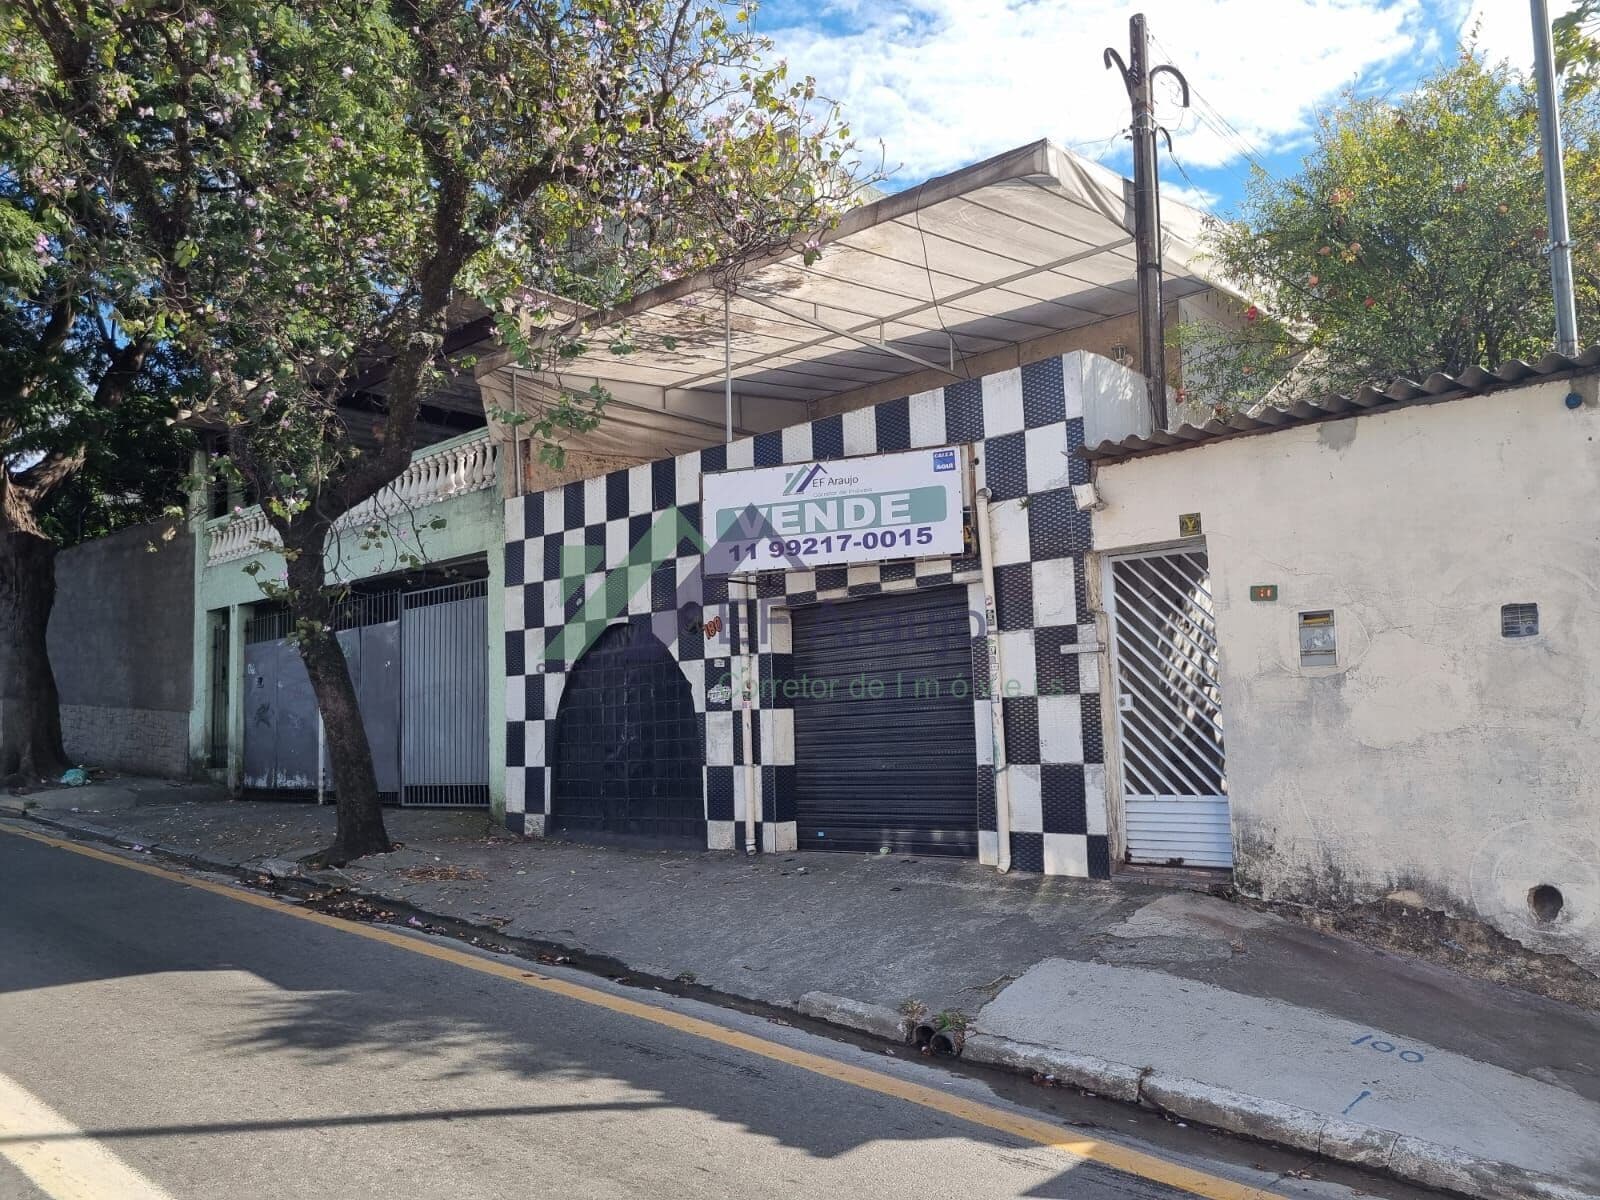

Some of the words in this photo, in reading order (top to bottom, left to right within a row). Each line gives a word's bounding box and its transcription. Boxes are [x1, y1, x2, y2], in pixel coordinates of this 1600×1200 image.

[812, 478, 825, 488] EF
[828, 476, 859, 486] Araujo
[734, 494, 911, 538] VENDE
[728, 543, 757, 562] 11
[769, 526, 933, 558] 99217-0015
[1351, 1034, 1424, 1063] 100
